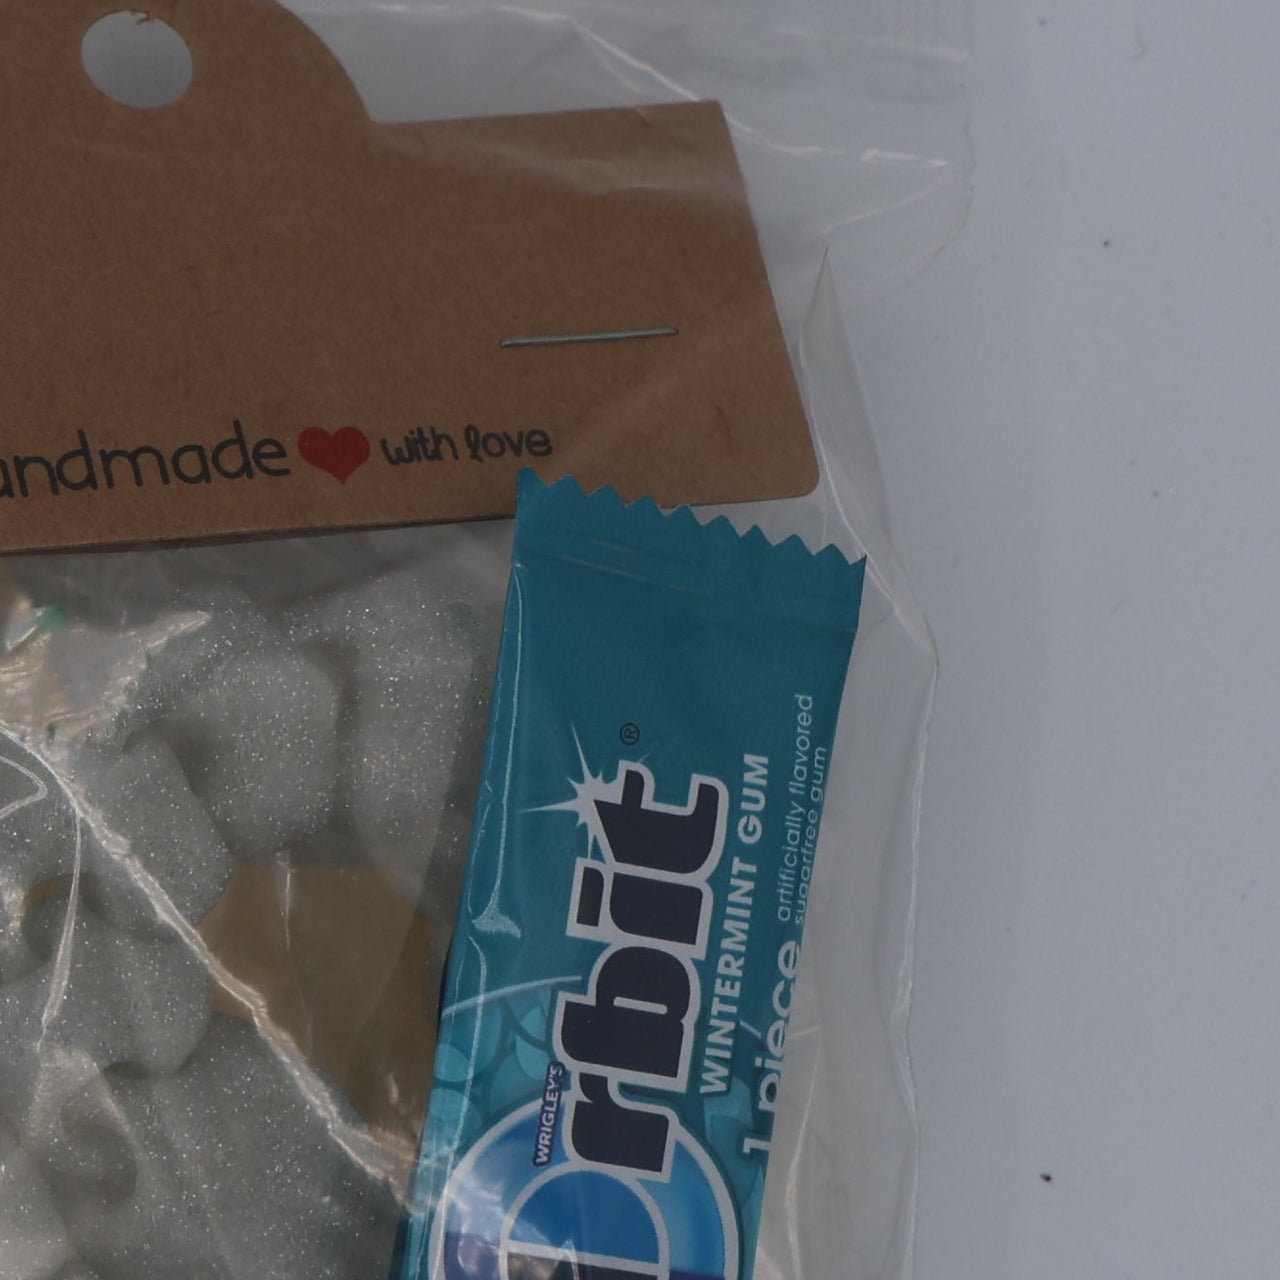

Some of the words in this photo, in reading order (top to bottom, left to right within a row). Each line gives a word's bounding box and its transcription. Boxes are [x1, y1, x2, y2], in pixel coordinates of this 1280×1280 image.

[380, 427, 459, 466] with
[463, 424, 553, 462] love
[788, 694, 813, 794] flavored
[810, 746, 828, 806] gum
[777, 794, 806, 922] artificially
[700, 856, 758, 1094] WINTERMINT
[737, 753, 769, 844] GUM
[536, 1064, 564, 1165] WRIGLEY'S
